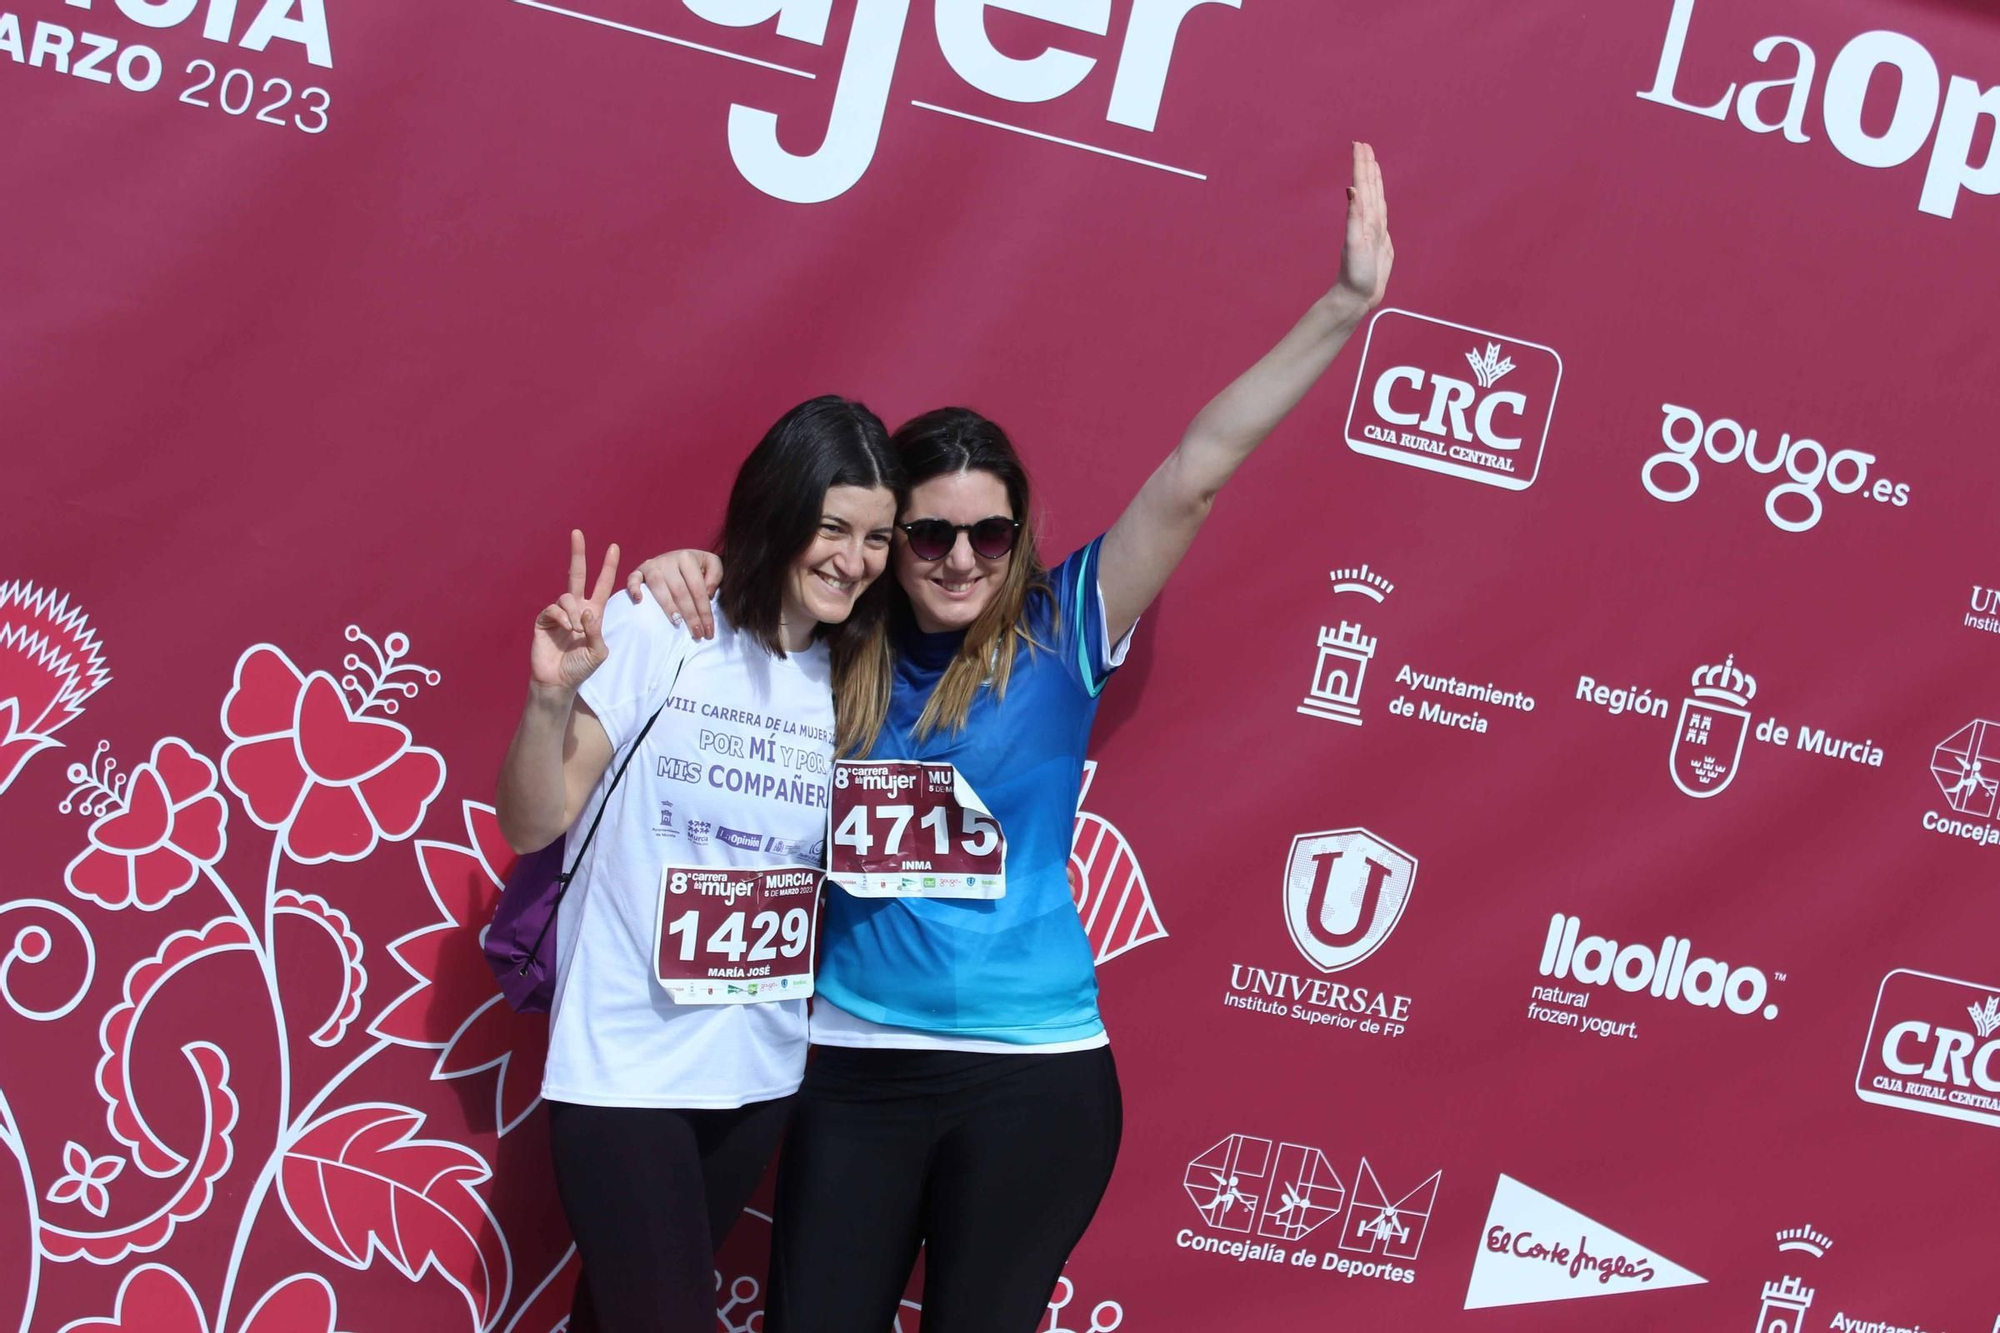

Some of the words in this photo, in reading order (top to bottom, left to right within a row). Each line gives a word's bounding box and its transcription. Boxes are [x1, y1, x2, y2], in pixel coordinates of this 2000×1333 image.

[179, 59, 330, 134] 2023
[1373, 365, 1527, 450] CRC
[1364, 425, 1397, 444] CAJA
[1399, 433, 1447, 456] RURAL
[1449, 445, 1515, 472] CENTRAL
[1964, 612, 2000, 634] Instit
[1395, 664, 1535, 712] Ayuntamiento
[701, 704, 761, 727] CARRERA
[765, 716, 781, 731] DE
[783, 721, 796, 735] LA
[800, 724, 827, 743] MUJER
[1389, 696, 1415, 717] de
[1418, 701, 1488, 733] Murcia
[1576, 675, 1669, 718] Región
[1755, 717, 1789, 746] de
[1796, 726, 1884, 767] Murcia
[657, 755, 702, 784] MIS
[700, 729, 744, 758] POR
[750, 732, 776, 763] MÍ
[780, 746, 794, 767] Y
[796, 749, 827, 775] POR
[852, 767, 888, 776] carrera
[862, 775, 917, 799] mujer
[834, 805, 999, 856] 4715
[1922, 811, 2000, 846] Conceja
[692, 873, 728, 882] carrera
[766, 872, 813, 889] MURCIA
[902, 861, 932, 870] INMA
[701, 881, 754, 906] mujer
[669, 908, 809, 961] 1429
[708, 967, 744, 978] MARÍA
[747, 965, 770, 977] JOSÉ
[1230, 964, 1411, 1021] UNIVERSAE
[1531, 985, 1590, 1008] natural
[1224, 992, 1287, 1016] Instituto
[1290, 1004, 1357, 1029] Superior
[1359, 1018, 1381, 1035] de
[1383, 1022, 1405, 1038] FP
[1527, 1003, 1578, 1027] frozen
[1580, 1016, 1638, 1039] yogurt.
[1873, 1076, 1903, 1093] CAJA
[1905, 1082, 1947, 1100] RURAL
[1176, 1229, 1284, 1262] Concejalía
[1290, 1249, 1317, 1268] de
[1321, 1253, 1416, 1284] Deportes
[1487, 1225, 1512, 1254] El
[1512, 1231, 1570, 1266] Corte
[1569, 1235, 1654, 1284] Inglés
